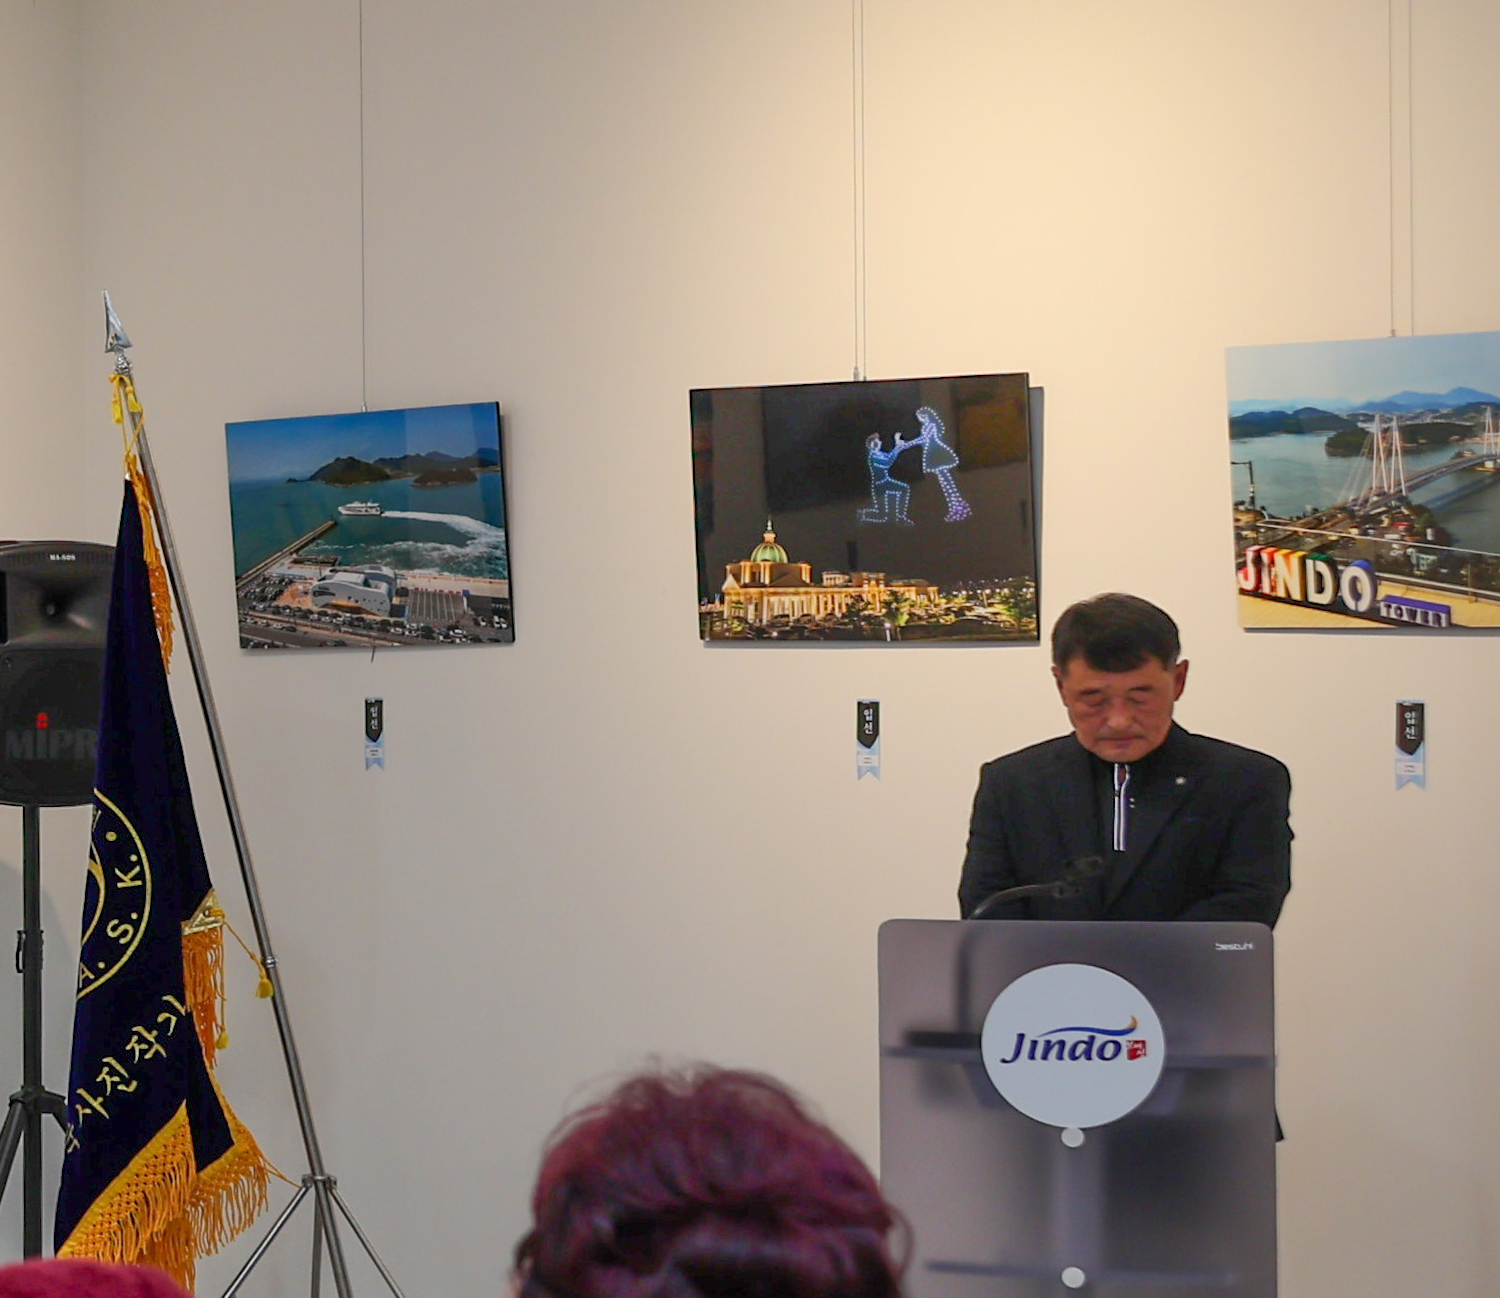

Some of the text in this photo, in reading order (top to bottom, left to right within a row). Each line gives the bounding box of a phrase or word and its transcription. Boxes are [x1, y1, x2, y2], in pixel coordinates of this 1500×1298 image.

[1237, 545, 1378, 613] JINDO
[1382, 602, 1446, 628] TOWER
[1000, 1032, 1122, 1064] Jindo
